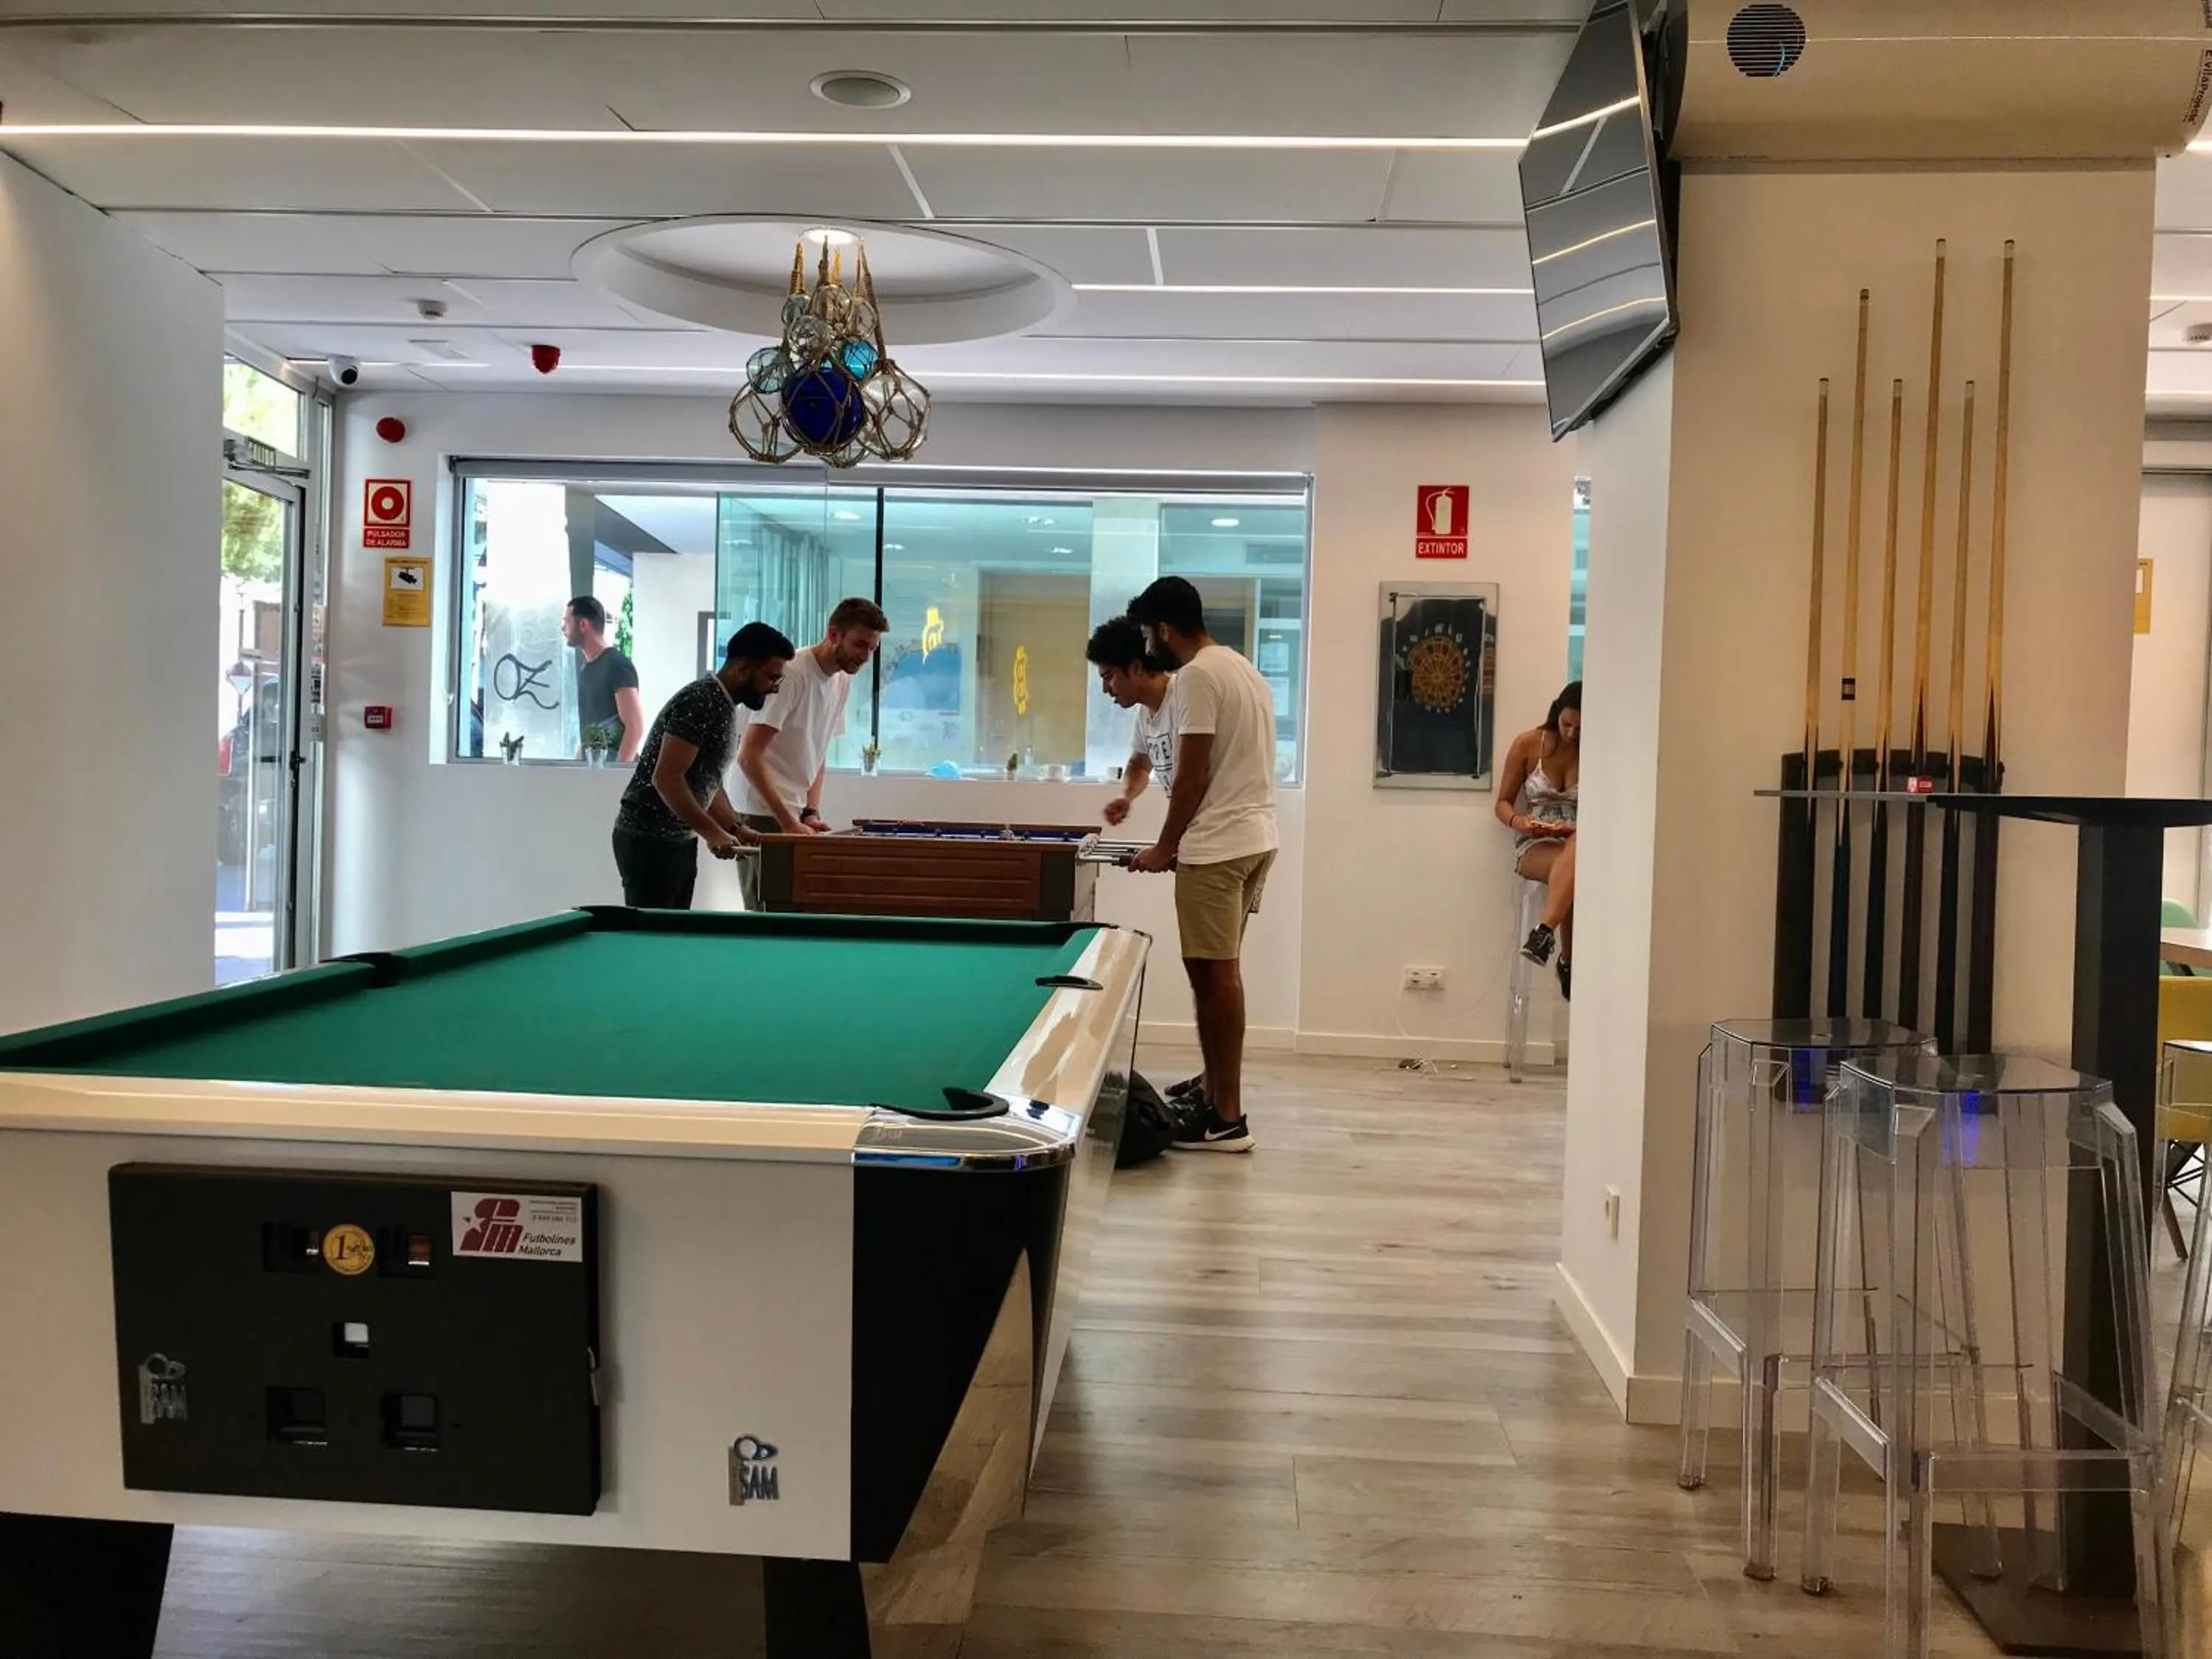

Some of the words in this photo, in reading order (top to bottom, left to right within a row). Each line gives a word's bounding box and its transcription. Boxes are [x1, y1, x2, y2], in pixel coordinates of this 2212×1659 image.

[1418, 542, 1464, 554] EXTINTOR
[523, 1232, 577, 1246] Futbolines
[518, 1245, 562, 1256] Mallorca
